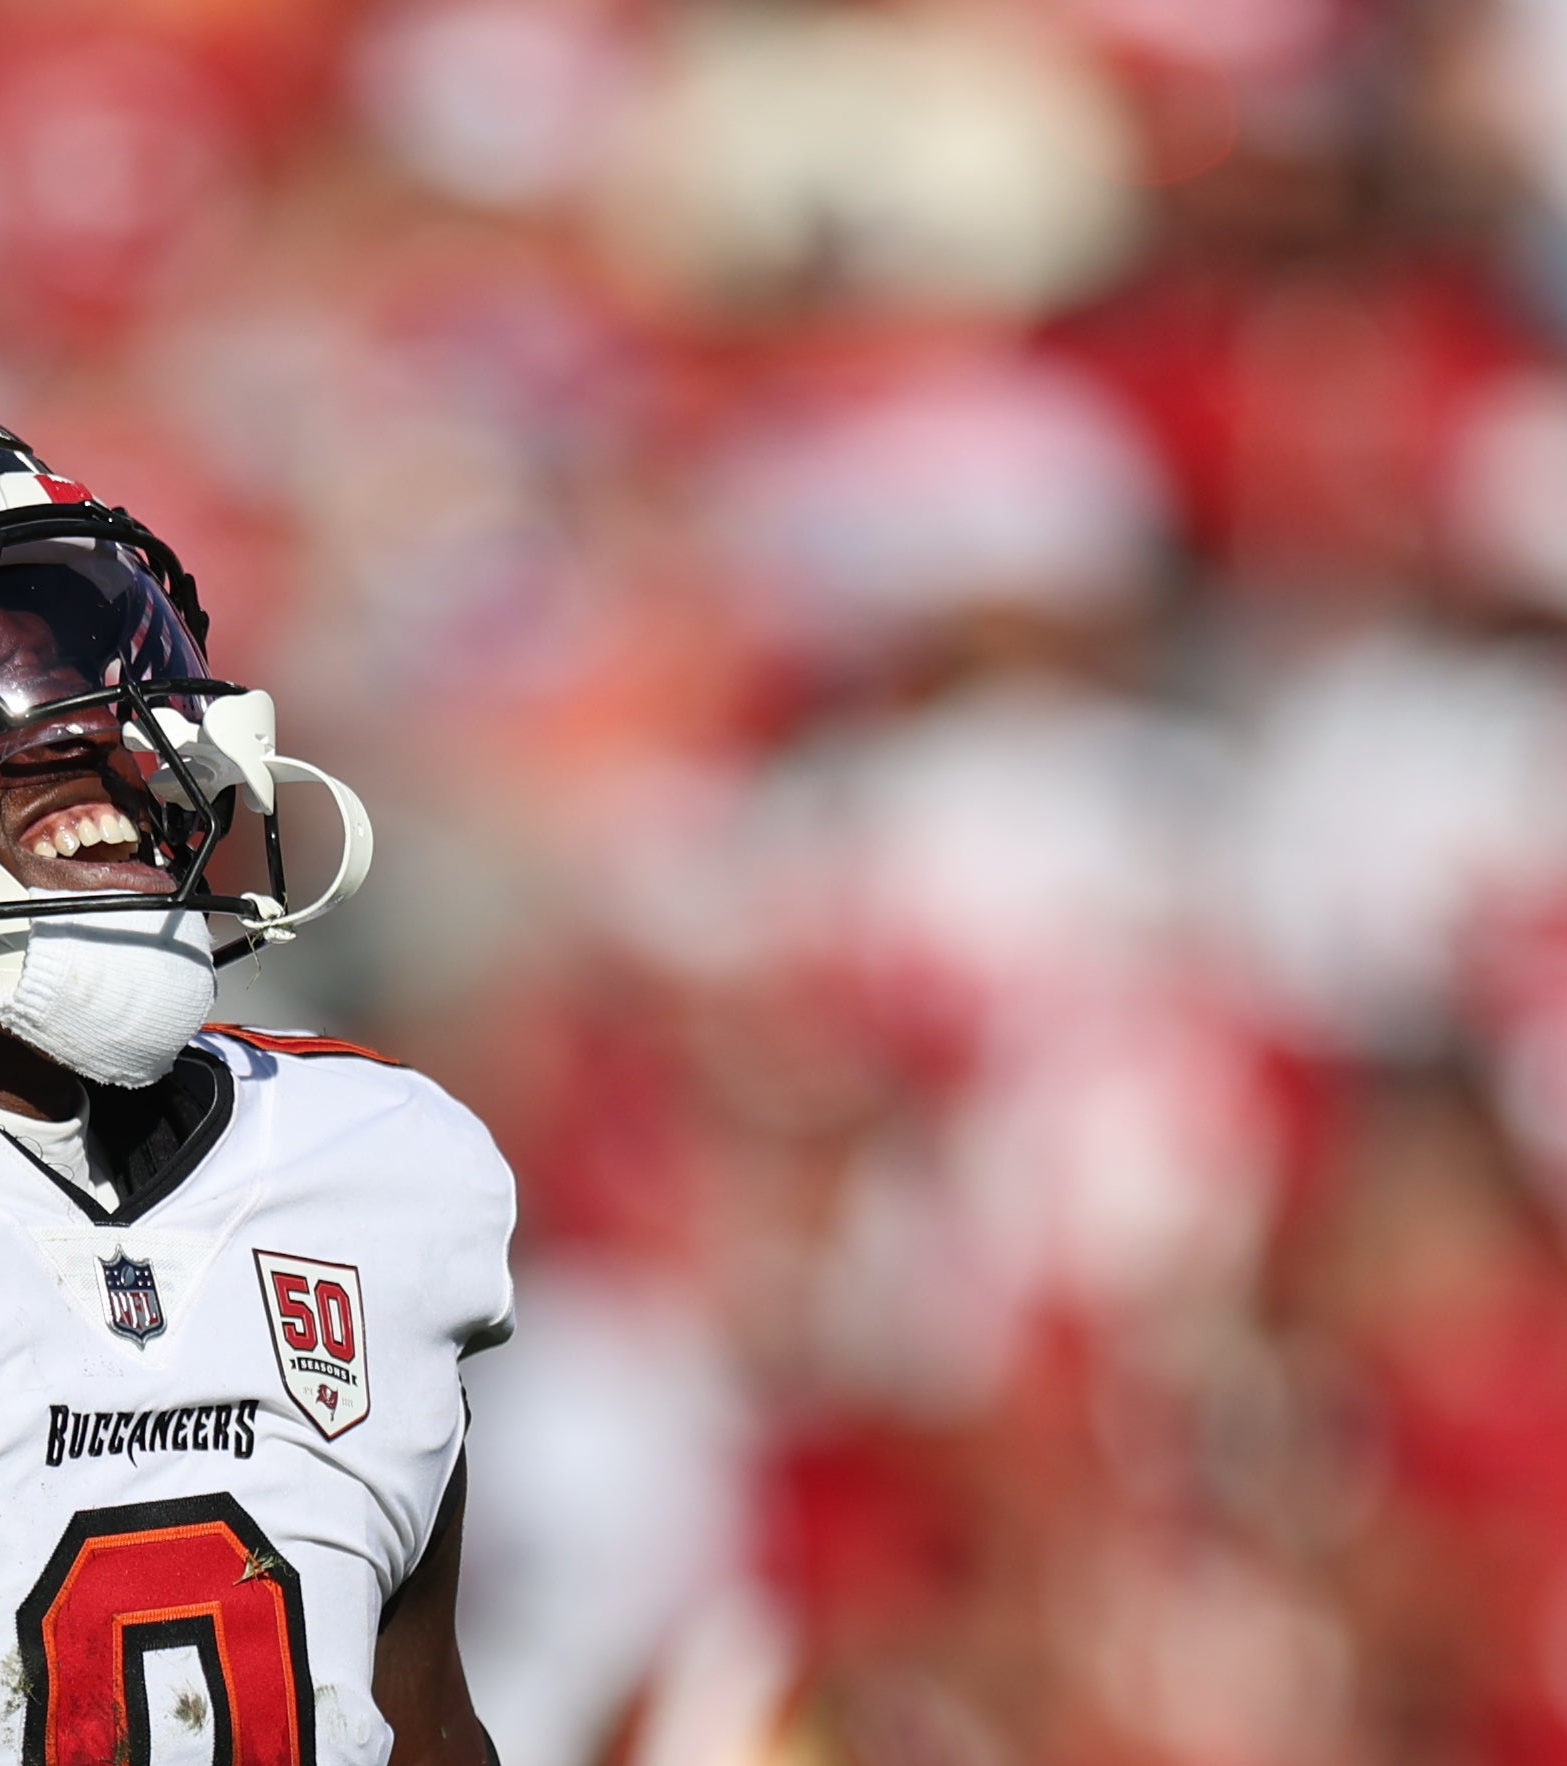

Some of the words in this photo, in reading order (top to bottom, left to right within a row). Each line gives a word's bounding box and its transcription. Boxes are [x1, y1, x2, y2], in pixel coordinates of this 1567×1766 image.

[110, 1291, 160, 1329] NFL
[271, 1270, 356, 1364] 50
[300, 1359, 348, 1381] SEASONS
[45, 1399, 260, 1468] BUCCANEERS
